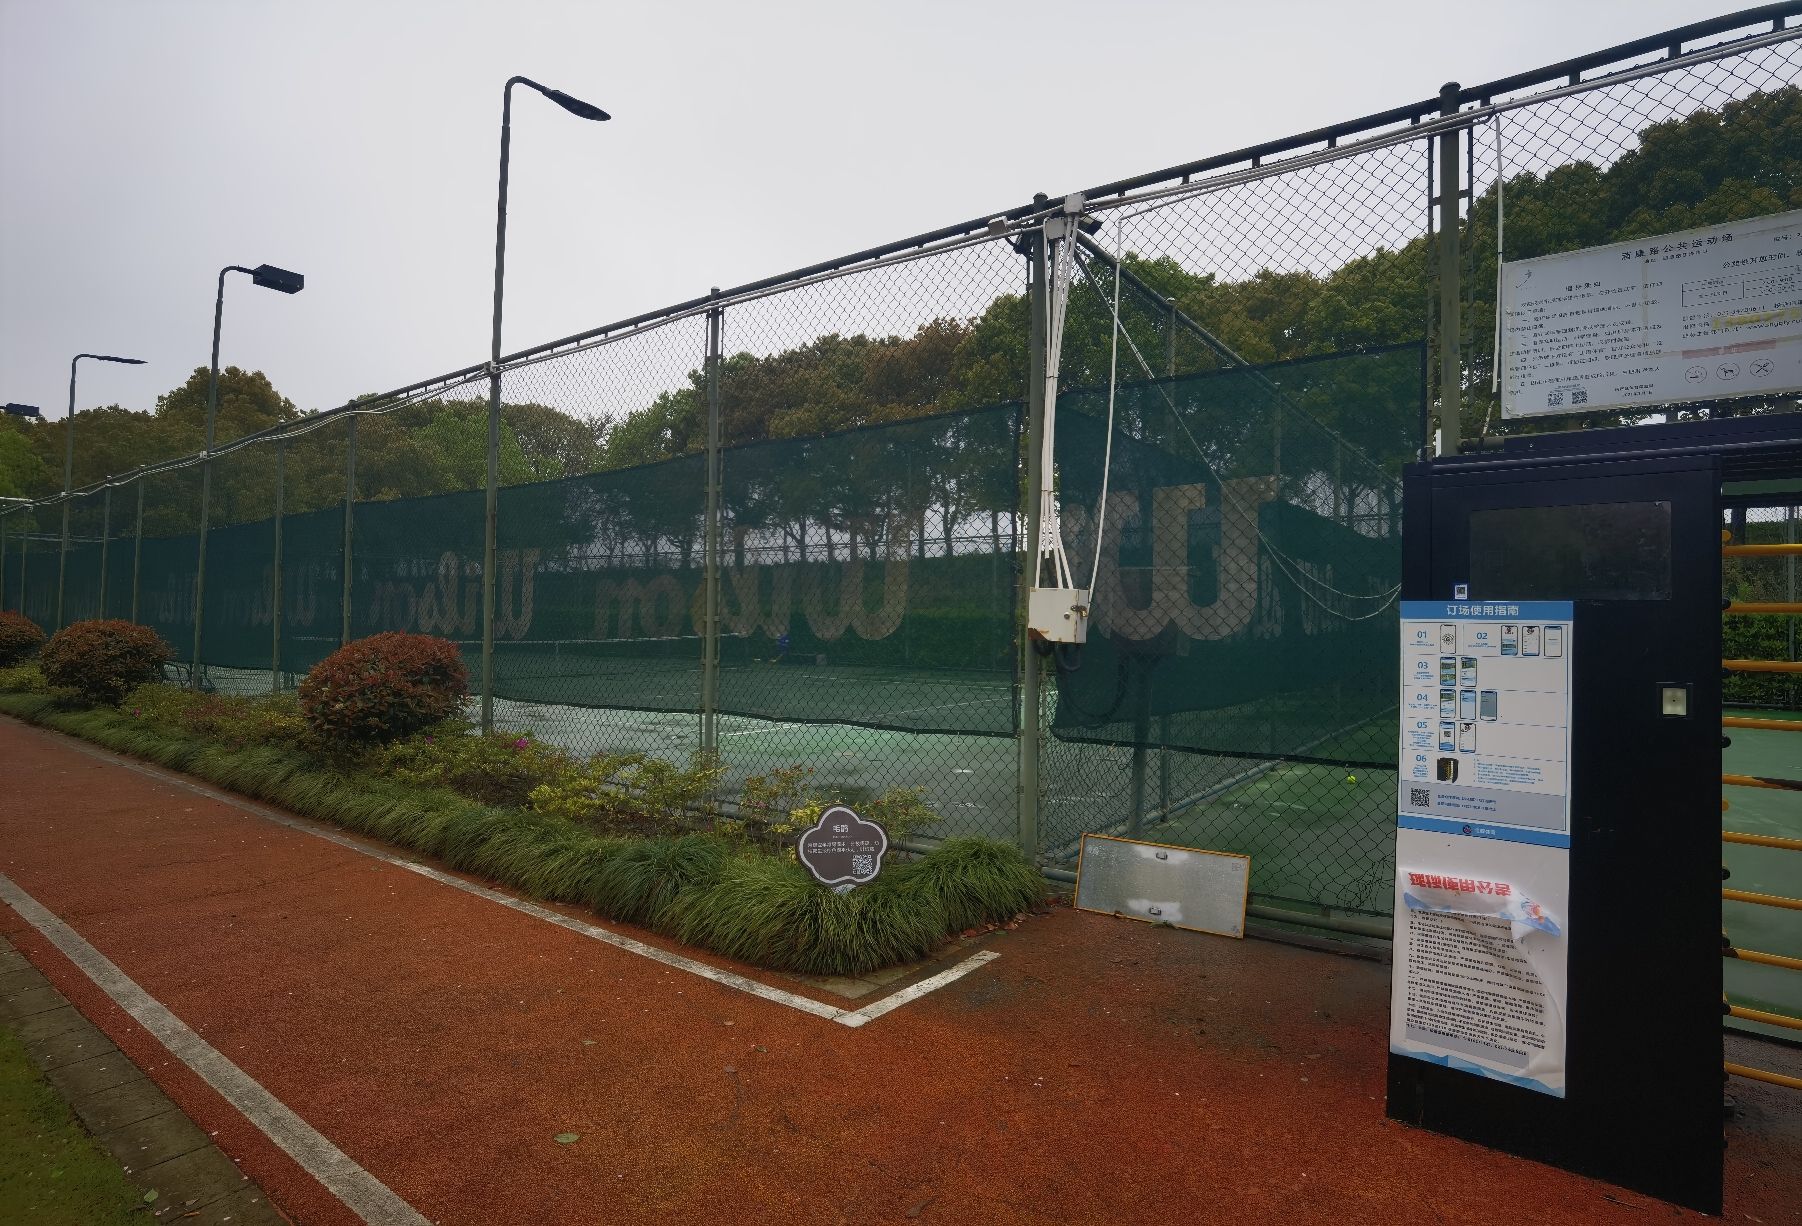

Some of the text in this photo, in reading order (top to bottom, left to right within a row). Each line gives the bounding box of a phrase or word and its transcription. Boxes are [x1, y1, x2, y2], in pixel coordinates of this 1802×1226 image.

[1446, 604, 1519, 617] 订场使用指南
[1416, 630, 1427, 639] 01
[1476, 632, 1488, 640] 02
[1417, 661, 1428, 670] 03
[1416, 693, 1428, 702] 04
[1416, 721, 1427, 729] 05
[1415, 754, 1427, 763] 06
